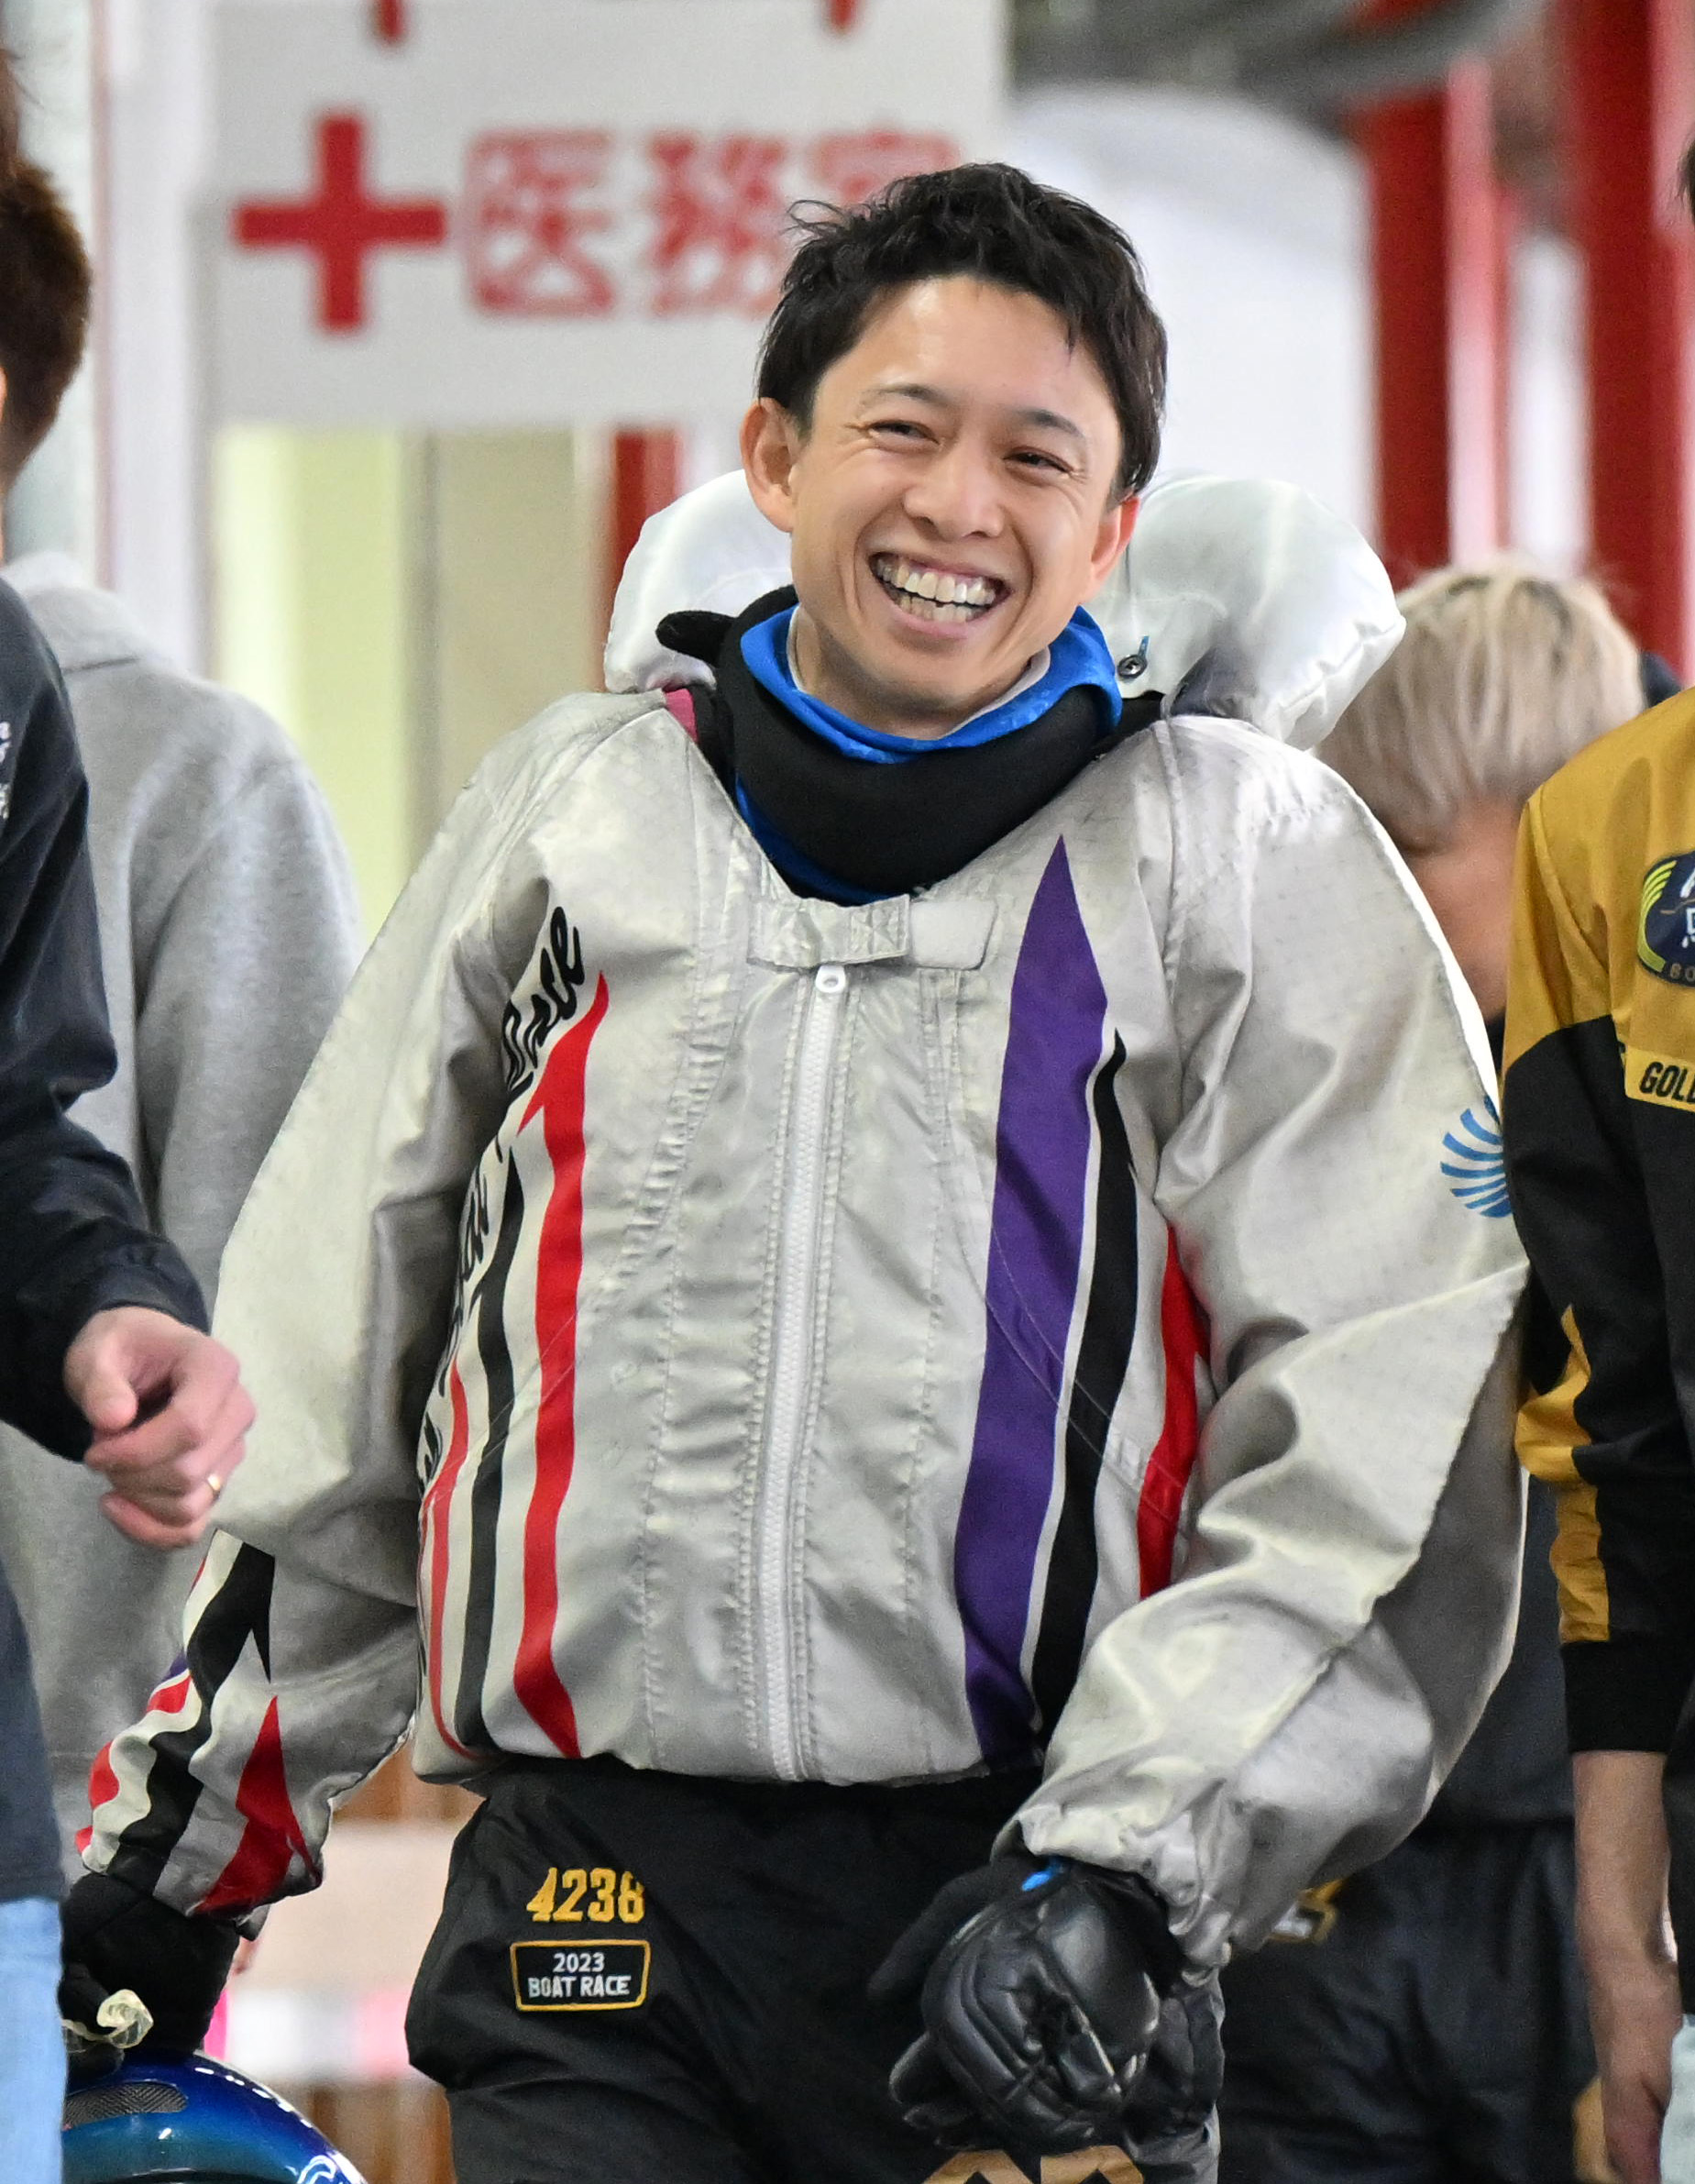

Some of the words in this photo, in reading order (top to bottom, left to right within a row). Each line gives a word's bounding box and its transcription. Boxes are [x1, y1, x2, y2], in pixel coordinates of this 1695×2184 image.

[552, 1952, 605, 1973] 2023
[527, 1976, 577, 1999] BOAT
[579, 1974, 632, 1996] RACE
